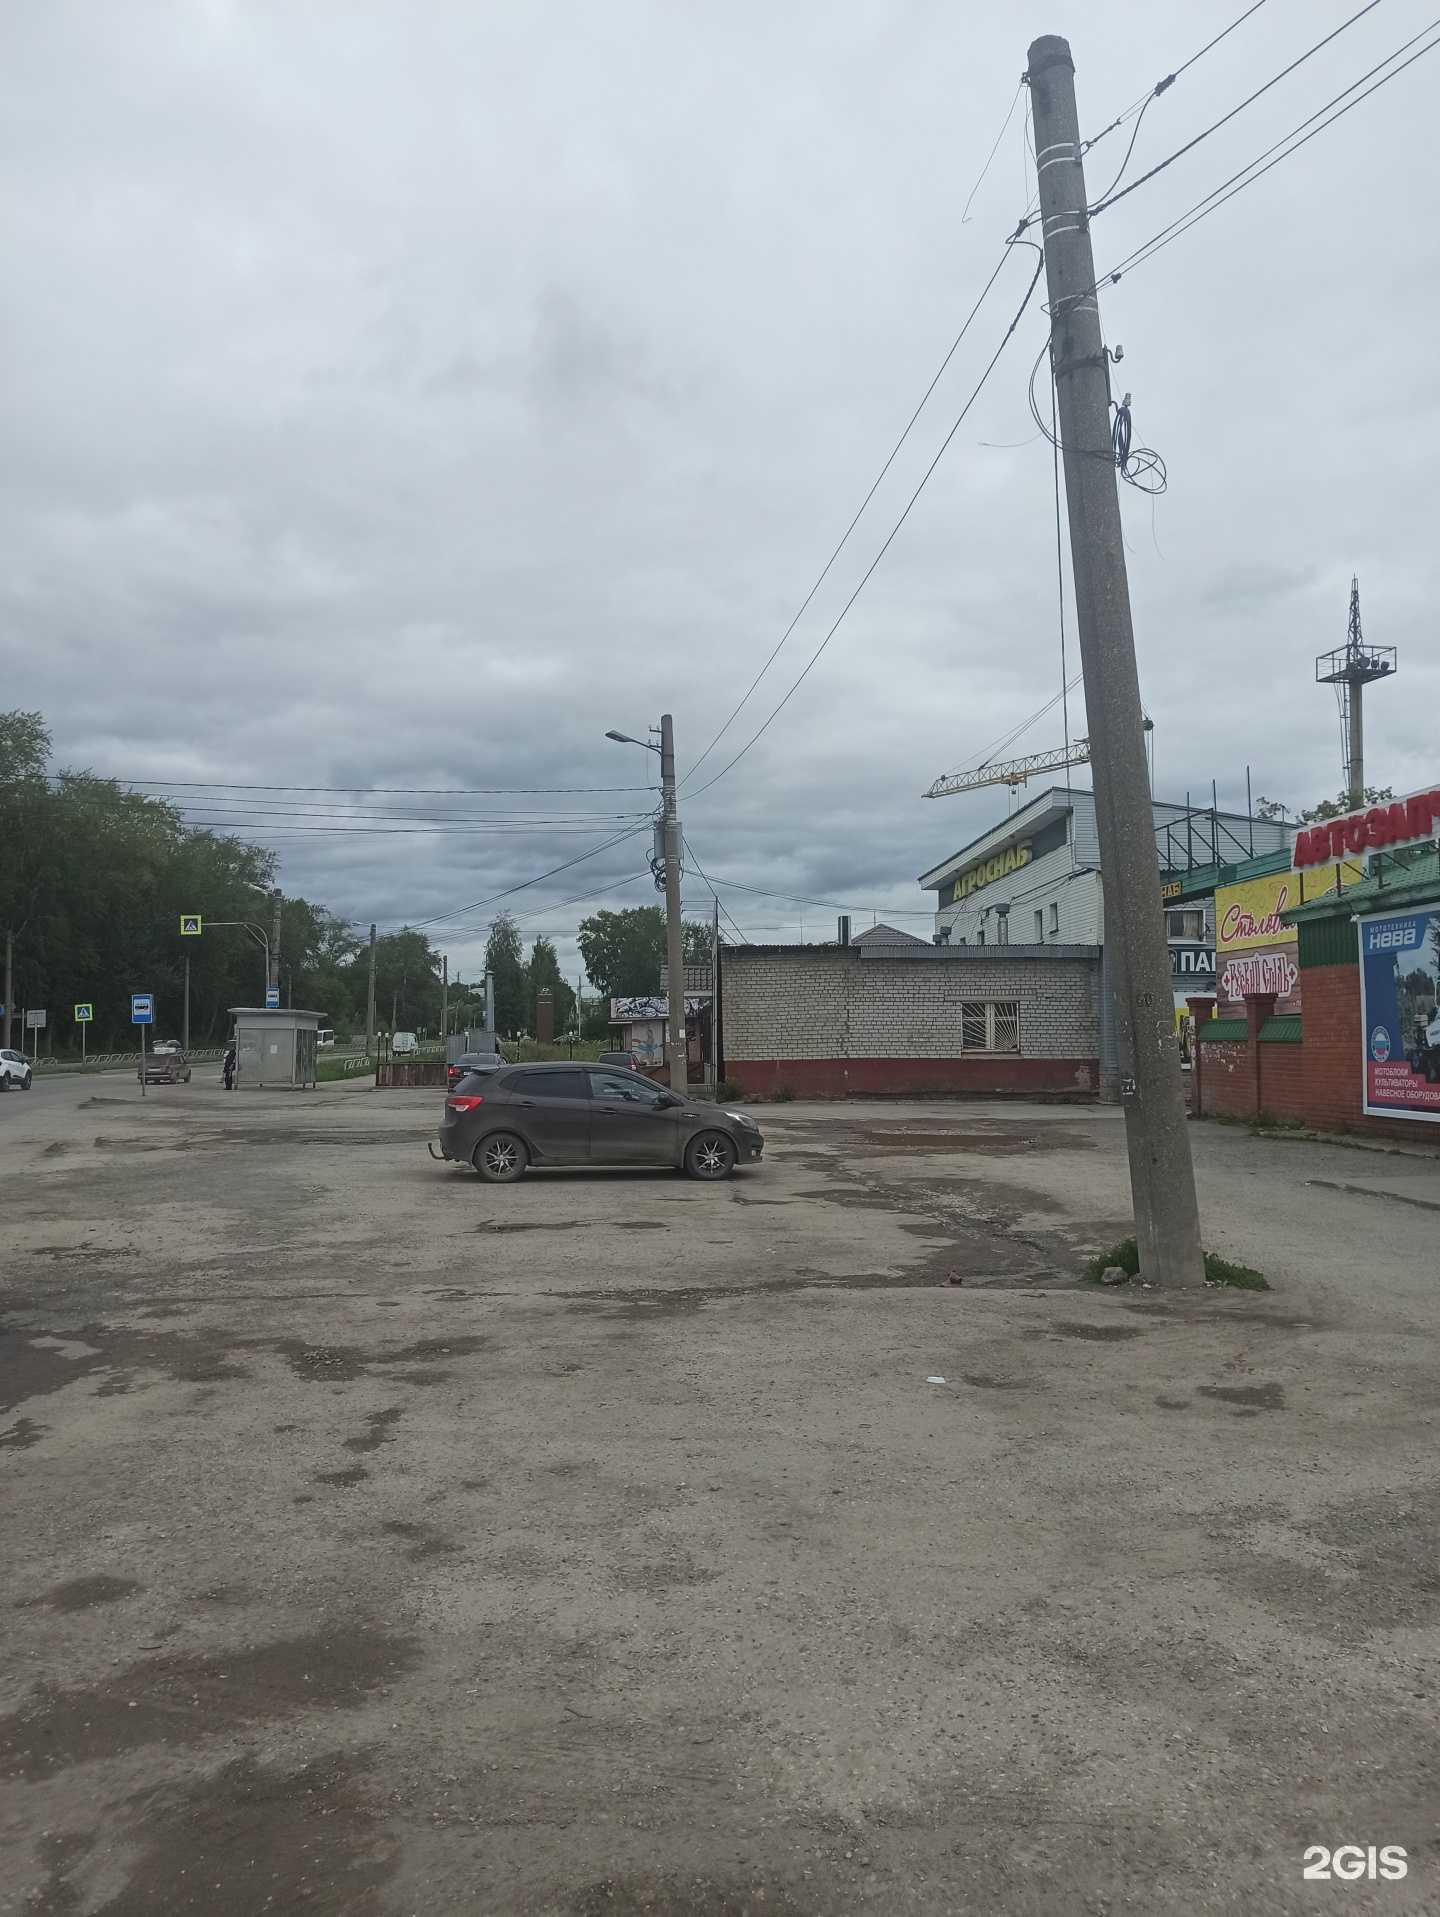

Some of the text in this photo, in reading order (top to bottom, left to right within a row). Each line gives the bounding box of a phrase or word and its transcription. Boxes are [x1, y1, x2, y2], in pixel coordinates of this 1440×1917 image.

[953, 839, 1031, 901] АГРОСНАБ
[1370, 920, 1416, 933] МОТОТЕХНИКА
[1375, 1067, 1409, 1076] МОТОБЛОКИ
[1375, 1079, 1418, 1088] КУЛЬТИВАТОРЫ
[1375, 1088, 1405, 1098] НАВЕСНОЕ
